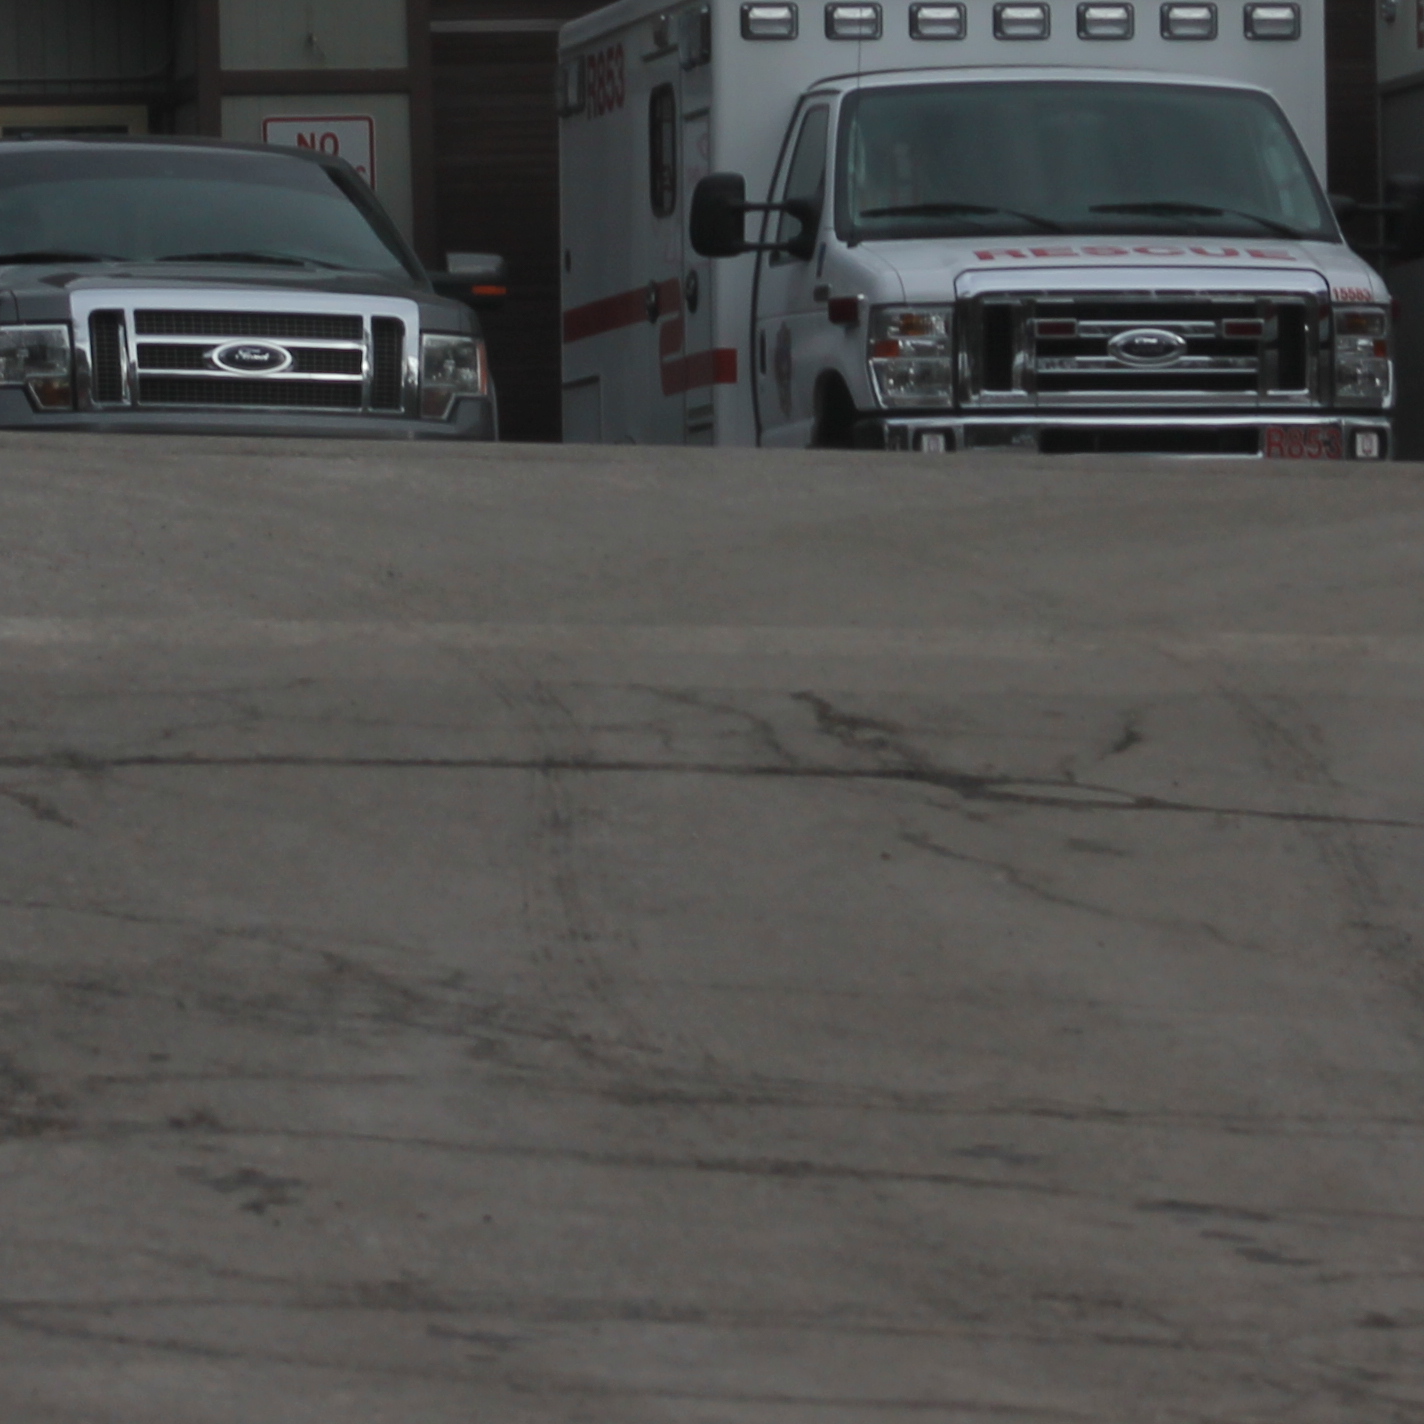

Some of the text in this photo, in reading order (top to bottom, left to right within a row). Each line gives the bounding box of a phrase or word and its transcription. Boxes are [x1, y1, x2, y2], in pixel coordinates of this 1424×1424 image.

[587, 43, 625, 120] R853
[297, 132, 339, 156] NO
[973, 245, 1297, 261] RESCUE
[1266, 426, 1343, 459] R853
